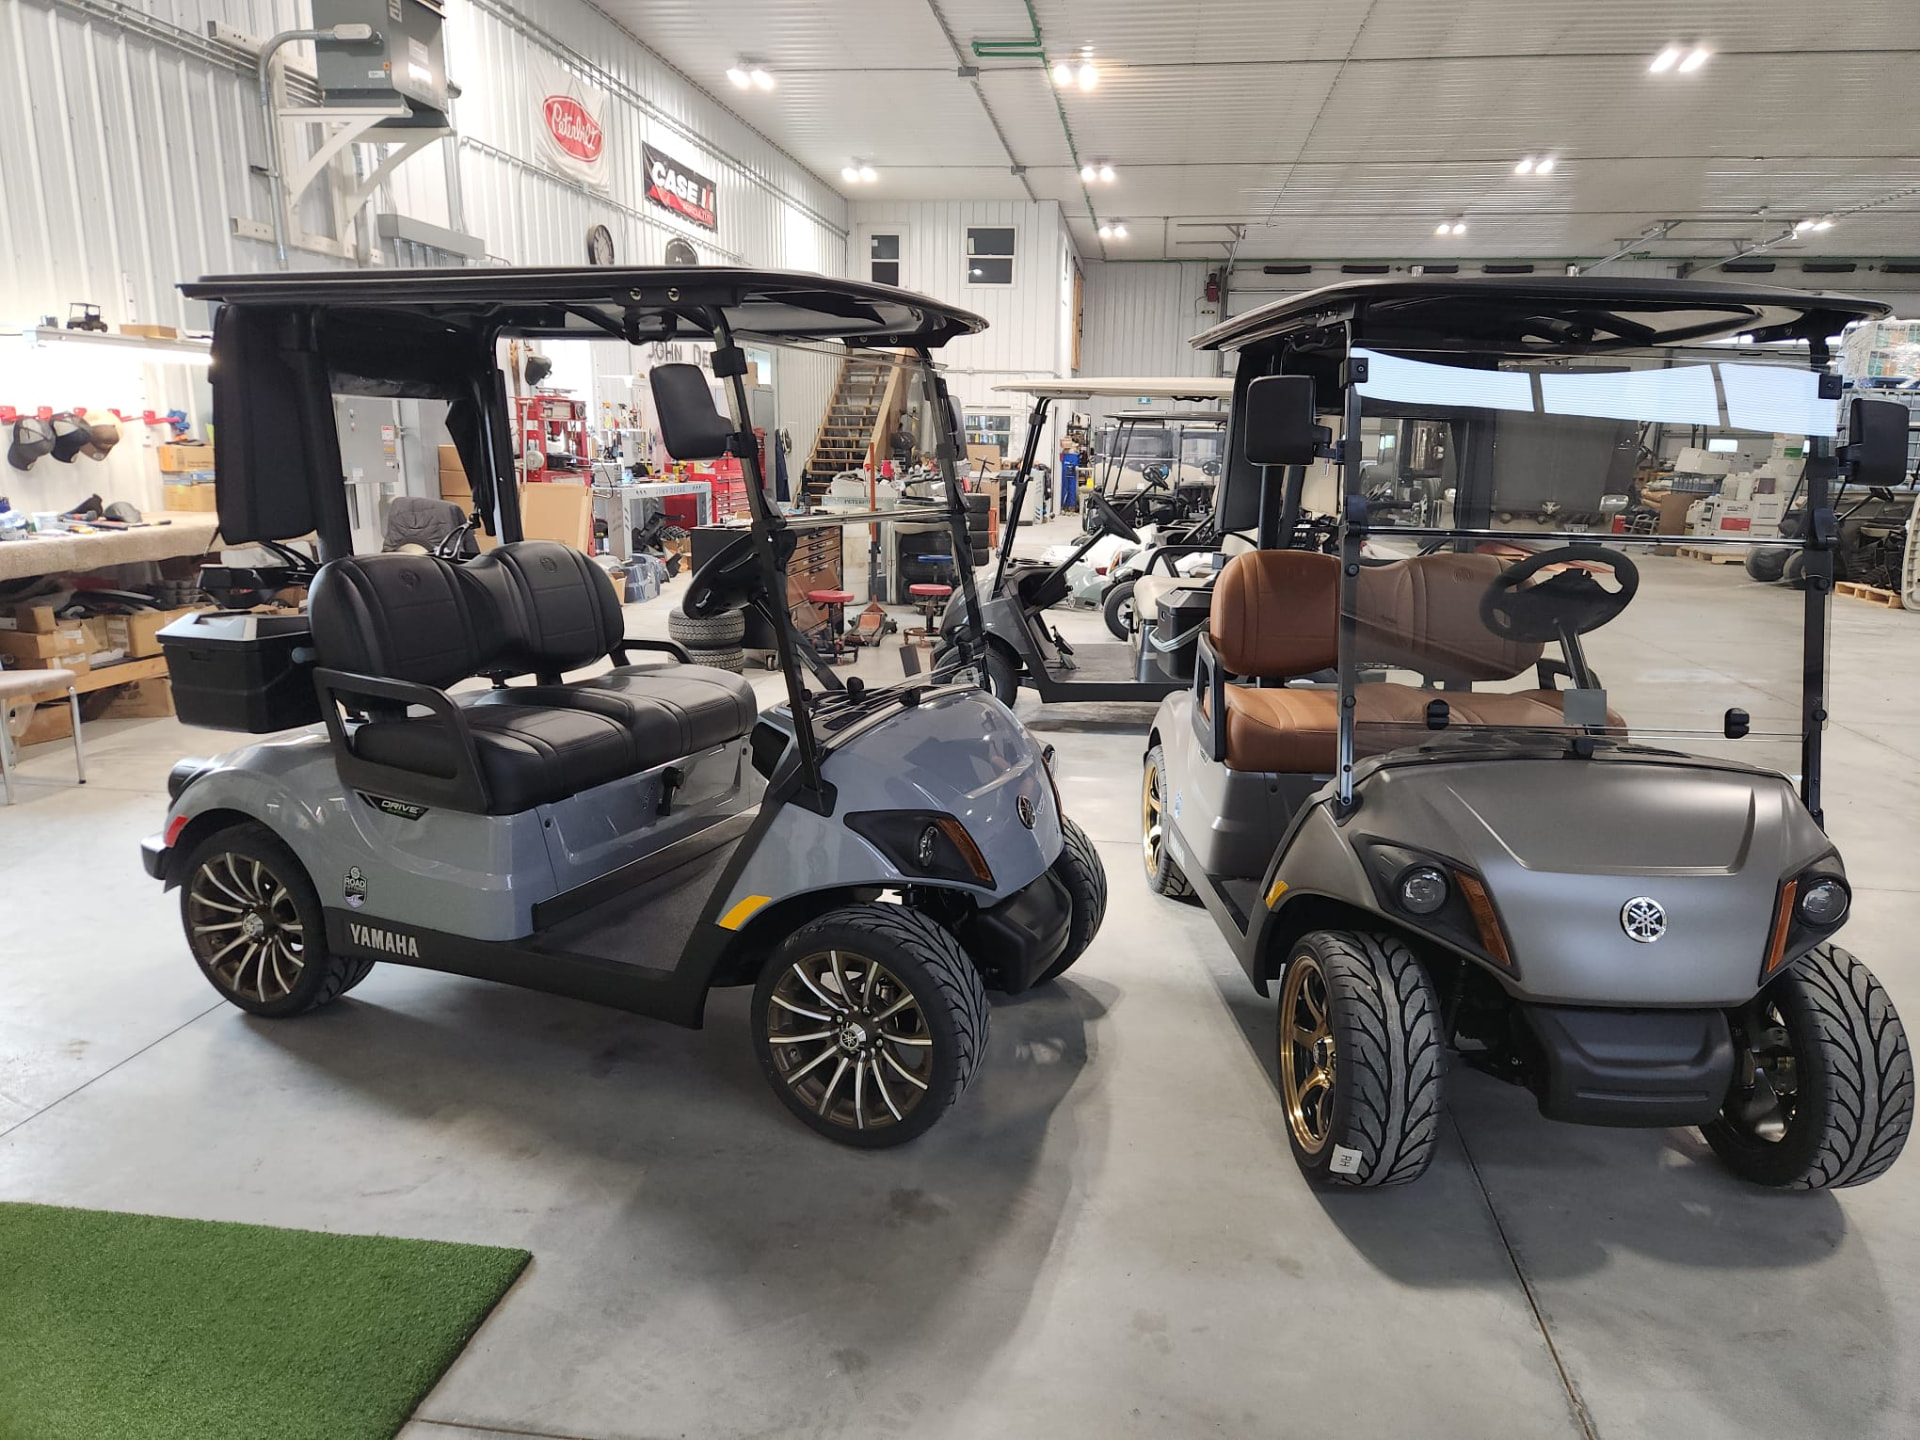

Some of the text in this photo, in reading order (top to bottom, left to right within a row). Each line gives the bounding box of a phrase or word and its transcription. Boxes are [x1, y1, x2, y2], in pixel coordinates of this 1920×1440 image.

[552, 103, 598, 150] Peterbilt
[652, 161, 699, 205] CASE
[648, 340, 683, 361] JOHN
[381, 800, 419, 814] DRIVE
[345, 877, 365, 888] ROAD
[350, 922, 419, 958] YAMAHA
